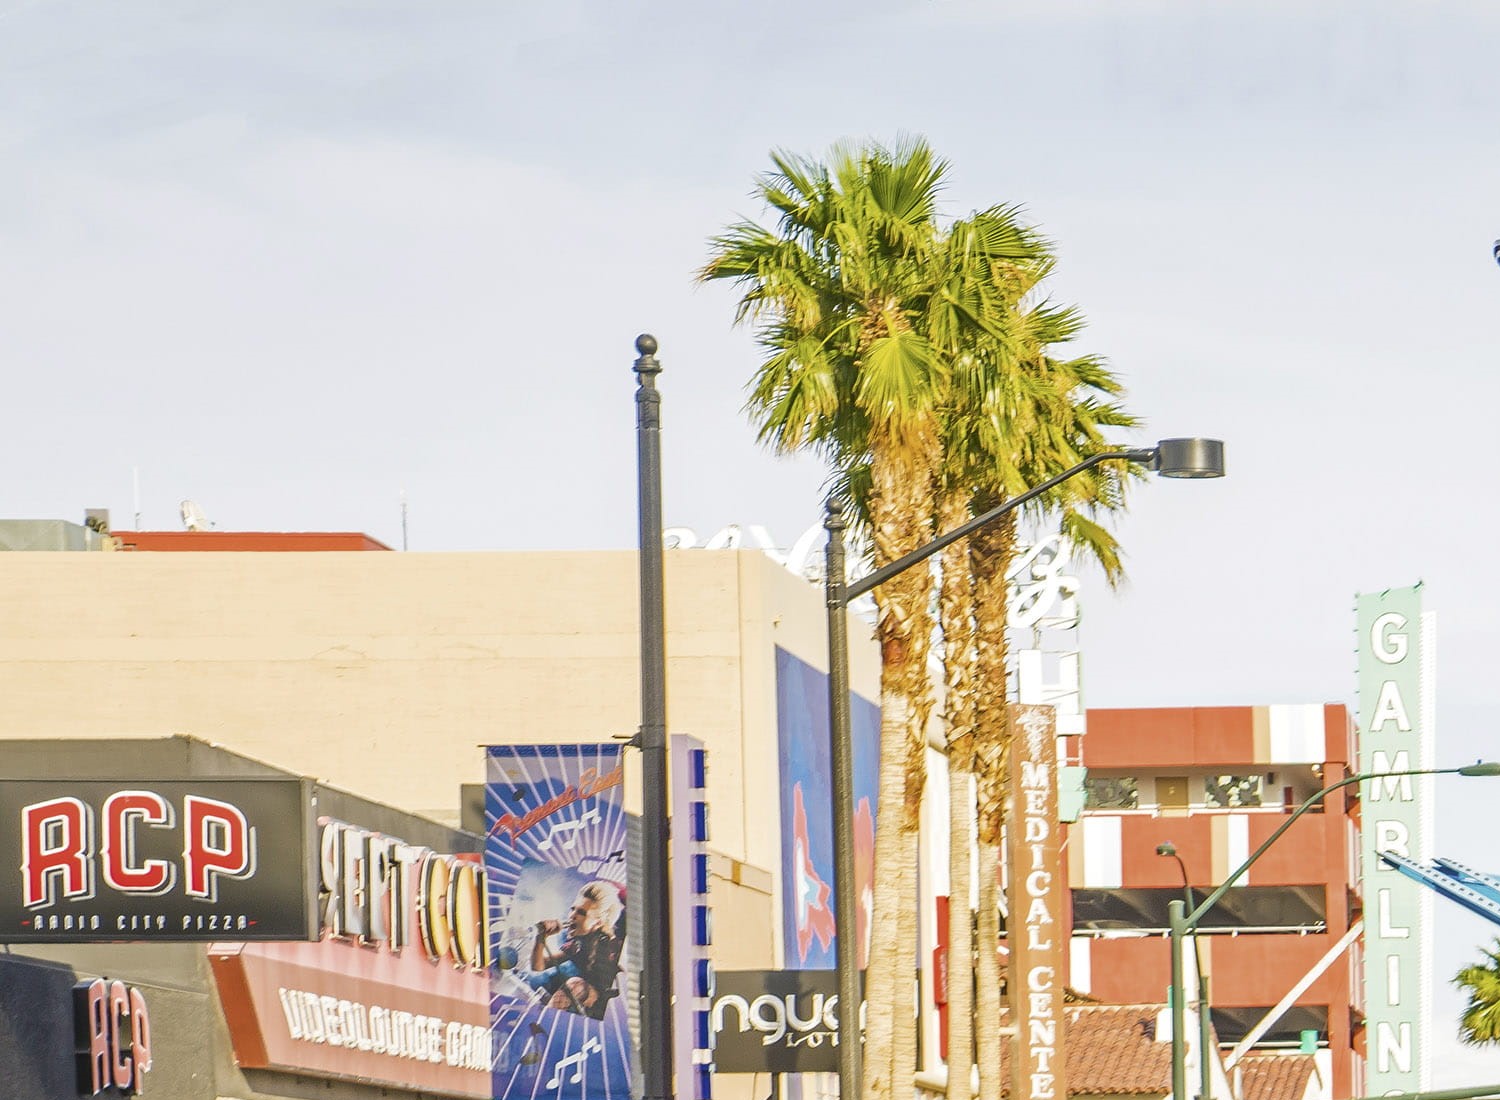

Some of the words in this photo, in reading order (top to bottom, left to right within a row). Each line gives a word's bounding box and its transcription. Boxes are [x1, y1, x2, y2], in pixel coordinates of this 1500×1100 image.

[20, 790, 253, 910] RCP
[1021, 761, 1053, 950] MEDICAL
[34, 914, 99, 931] RADIO
[117, 914, 166, 931] CITY
[182, 914, 248, 931] PIZZA
[88, 977, 152, 1096] RCP
